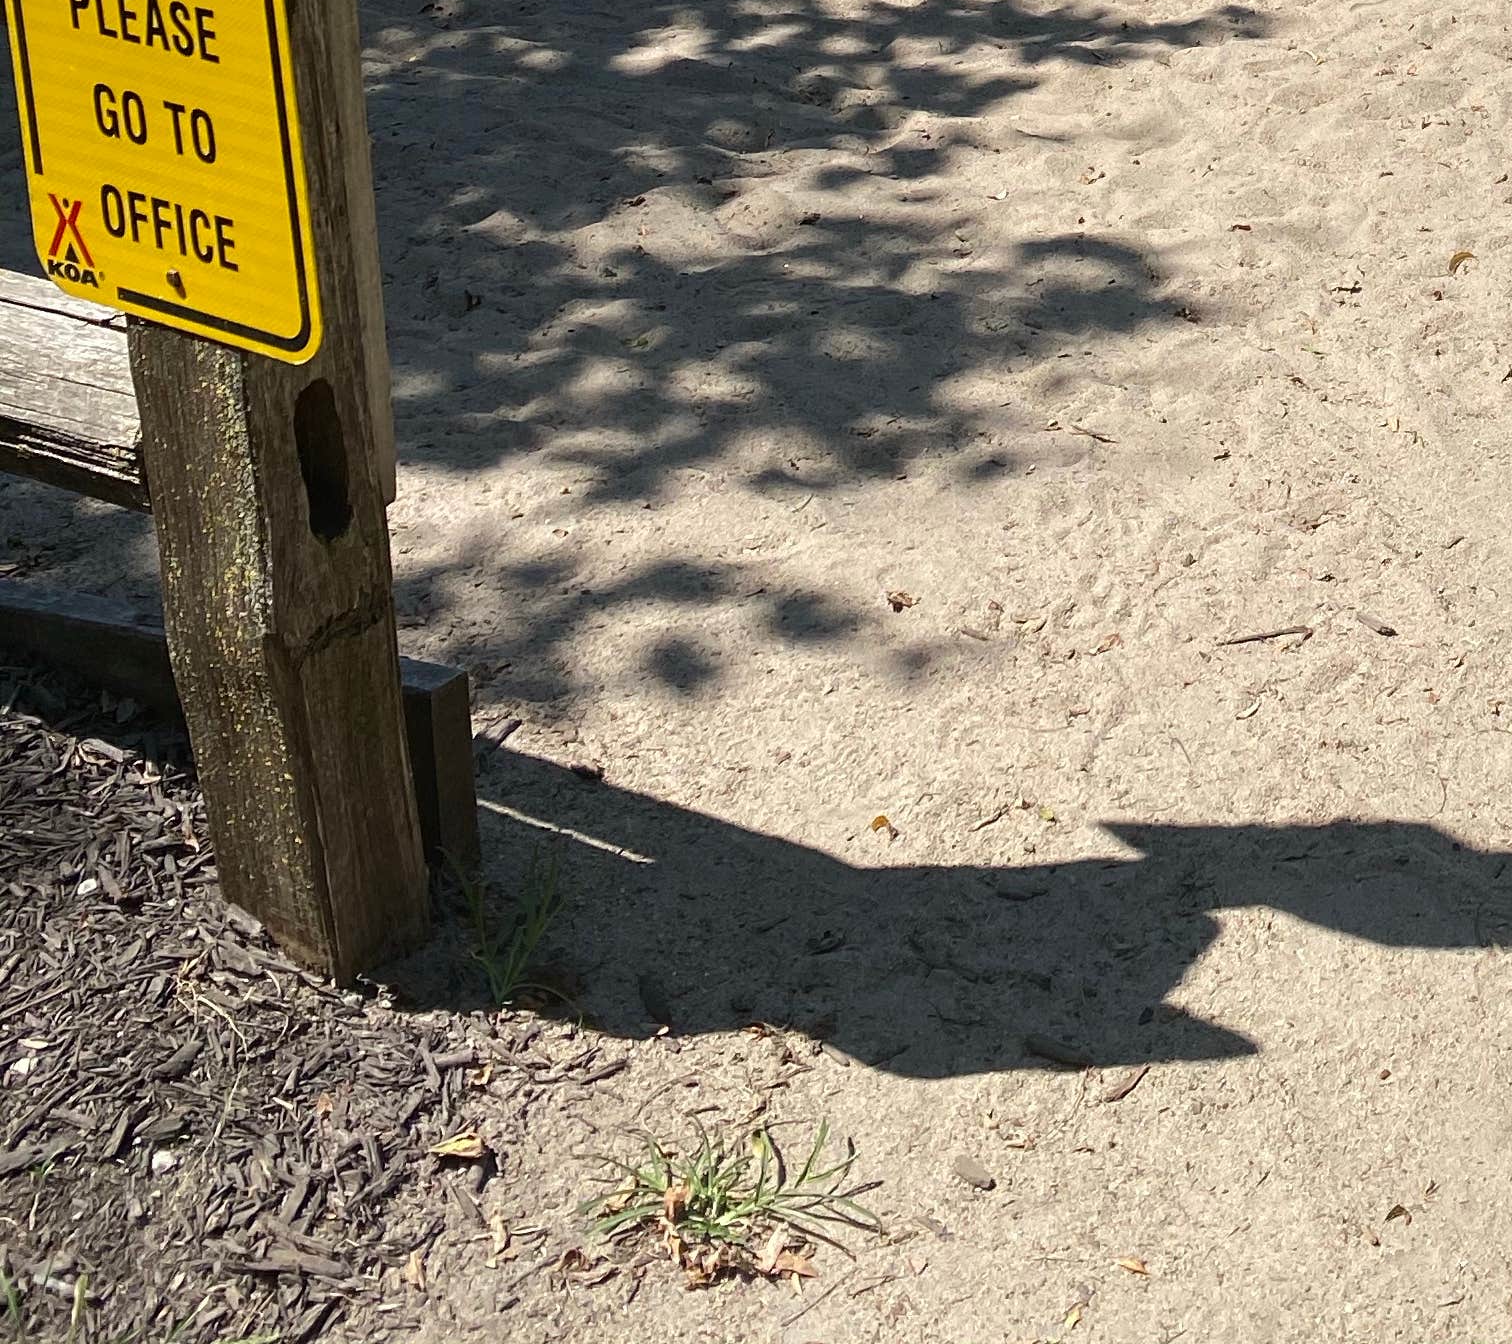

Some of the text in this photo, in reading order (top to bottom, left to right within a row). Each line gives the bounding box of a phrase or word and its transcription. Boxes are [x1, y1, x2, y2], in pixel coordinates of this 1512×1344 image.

[93, 83, 217, 164] GO TO
[100, 183, 239, 272] OFFICE
[47, 258, 99, 289] KOA
